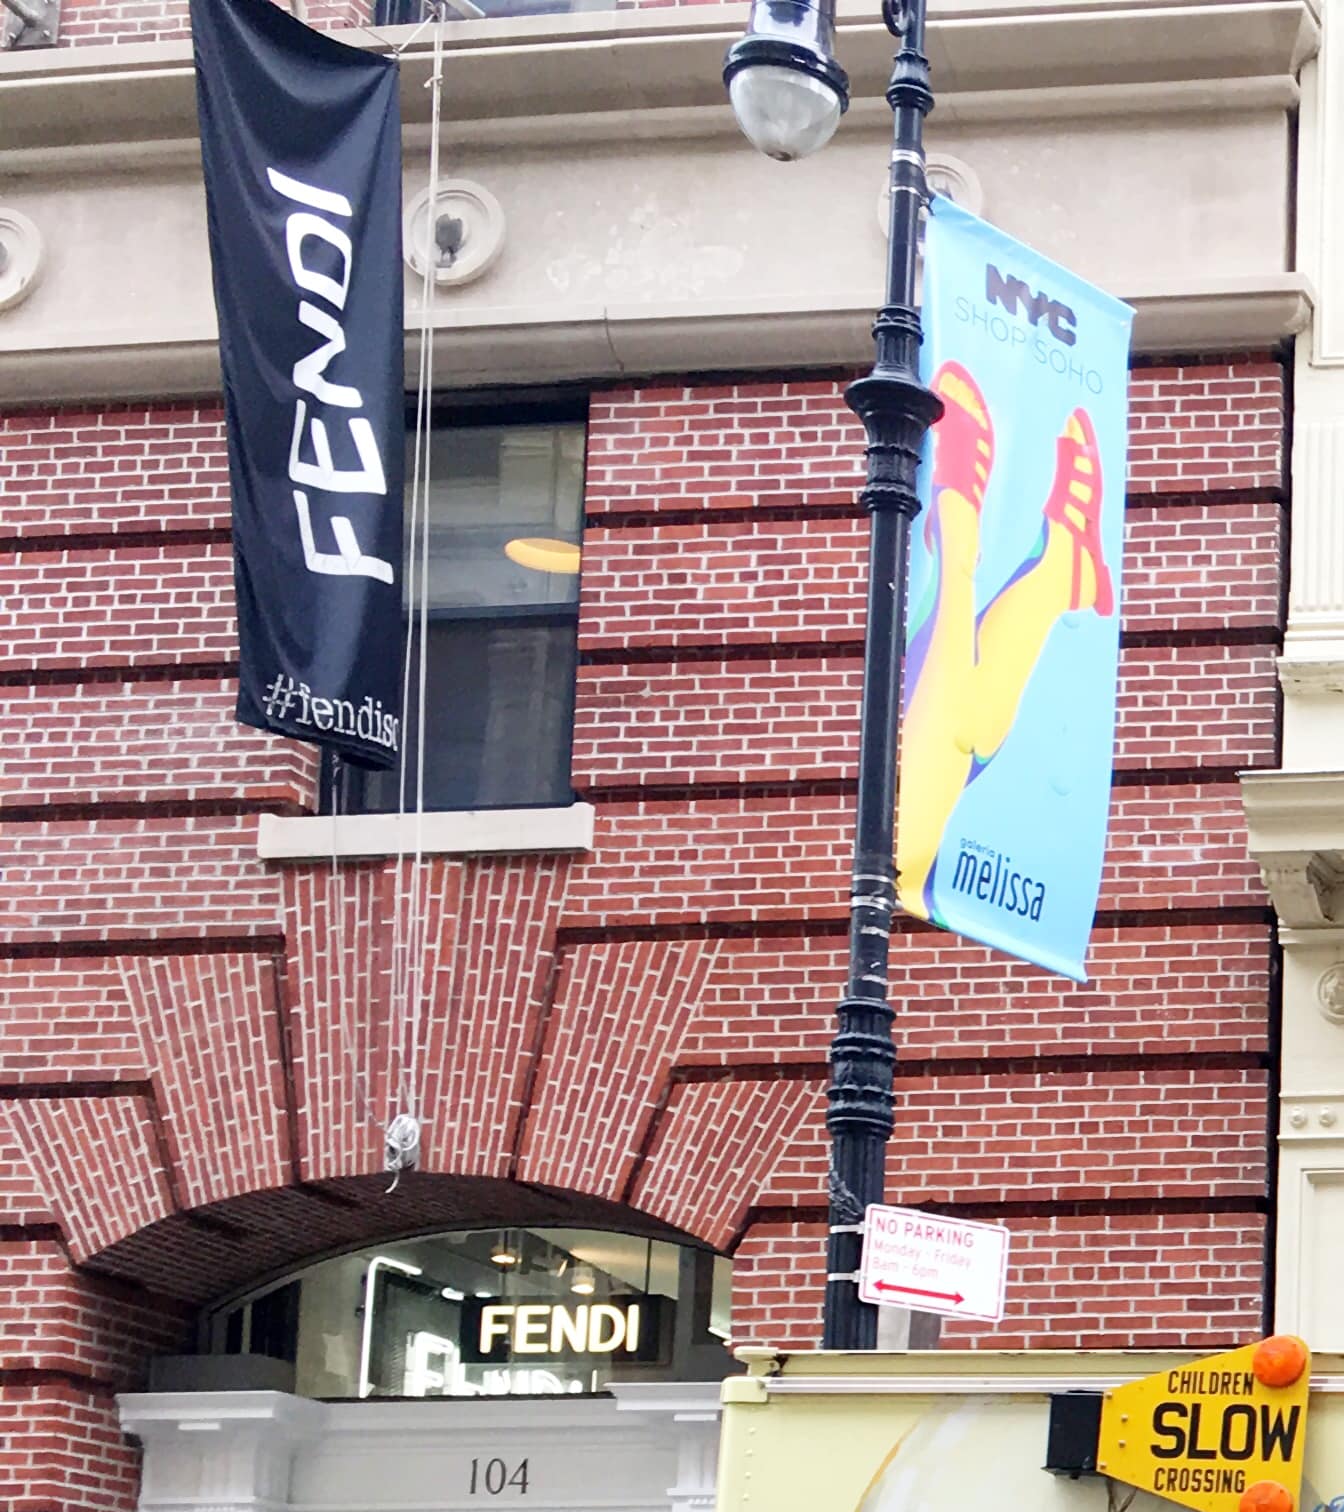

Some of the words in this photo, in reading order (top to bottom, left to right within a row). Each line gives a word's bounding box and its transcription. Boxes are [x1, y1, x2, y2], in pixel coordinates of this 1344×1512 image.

[985, 262, 1078, 348] NYC
[954, 296, 1027, 348] SHOP
[1033, 338, 1104, 395] SOHO
[266, 166, 396, 587] FENDI
[951, 851, 1046, 923] melissa
[875, 1216, 898, 1235] NO
[903, 1221, 975, 1249] PARKING
[478, 1303, 640, 1354] FENDI
[1167, 1370, 1255, 1396] CHILDREN
[1150, 1402, 1301, 1462] SLOW
[468, 1457, 531, 1496] 104
[1153, 1467, 1246, 1493] CROSSING
